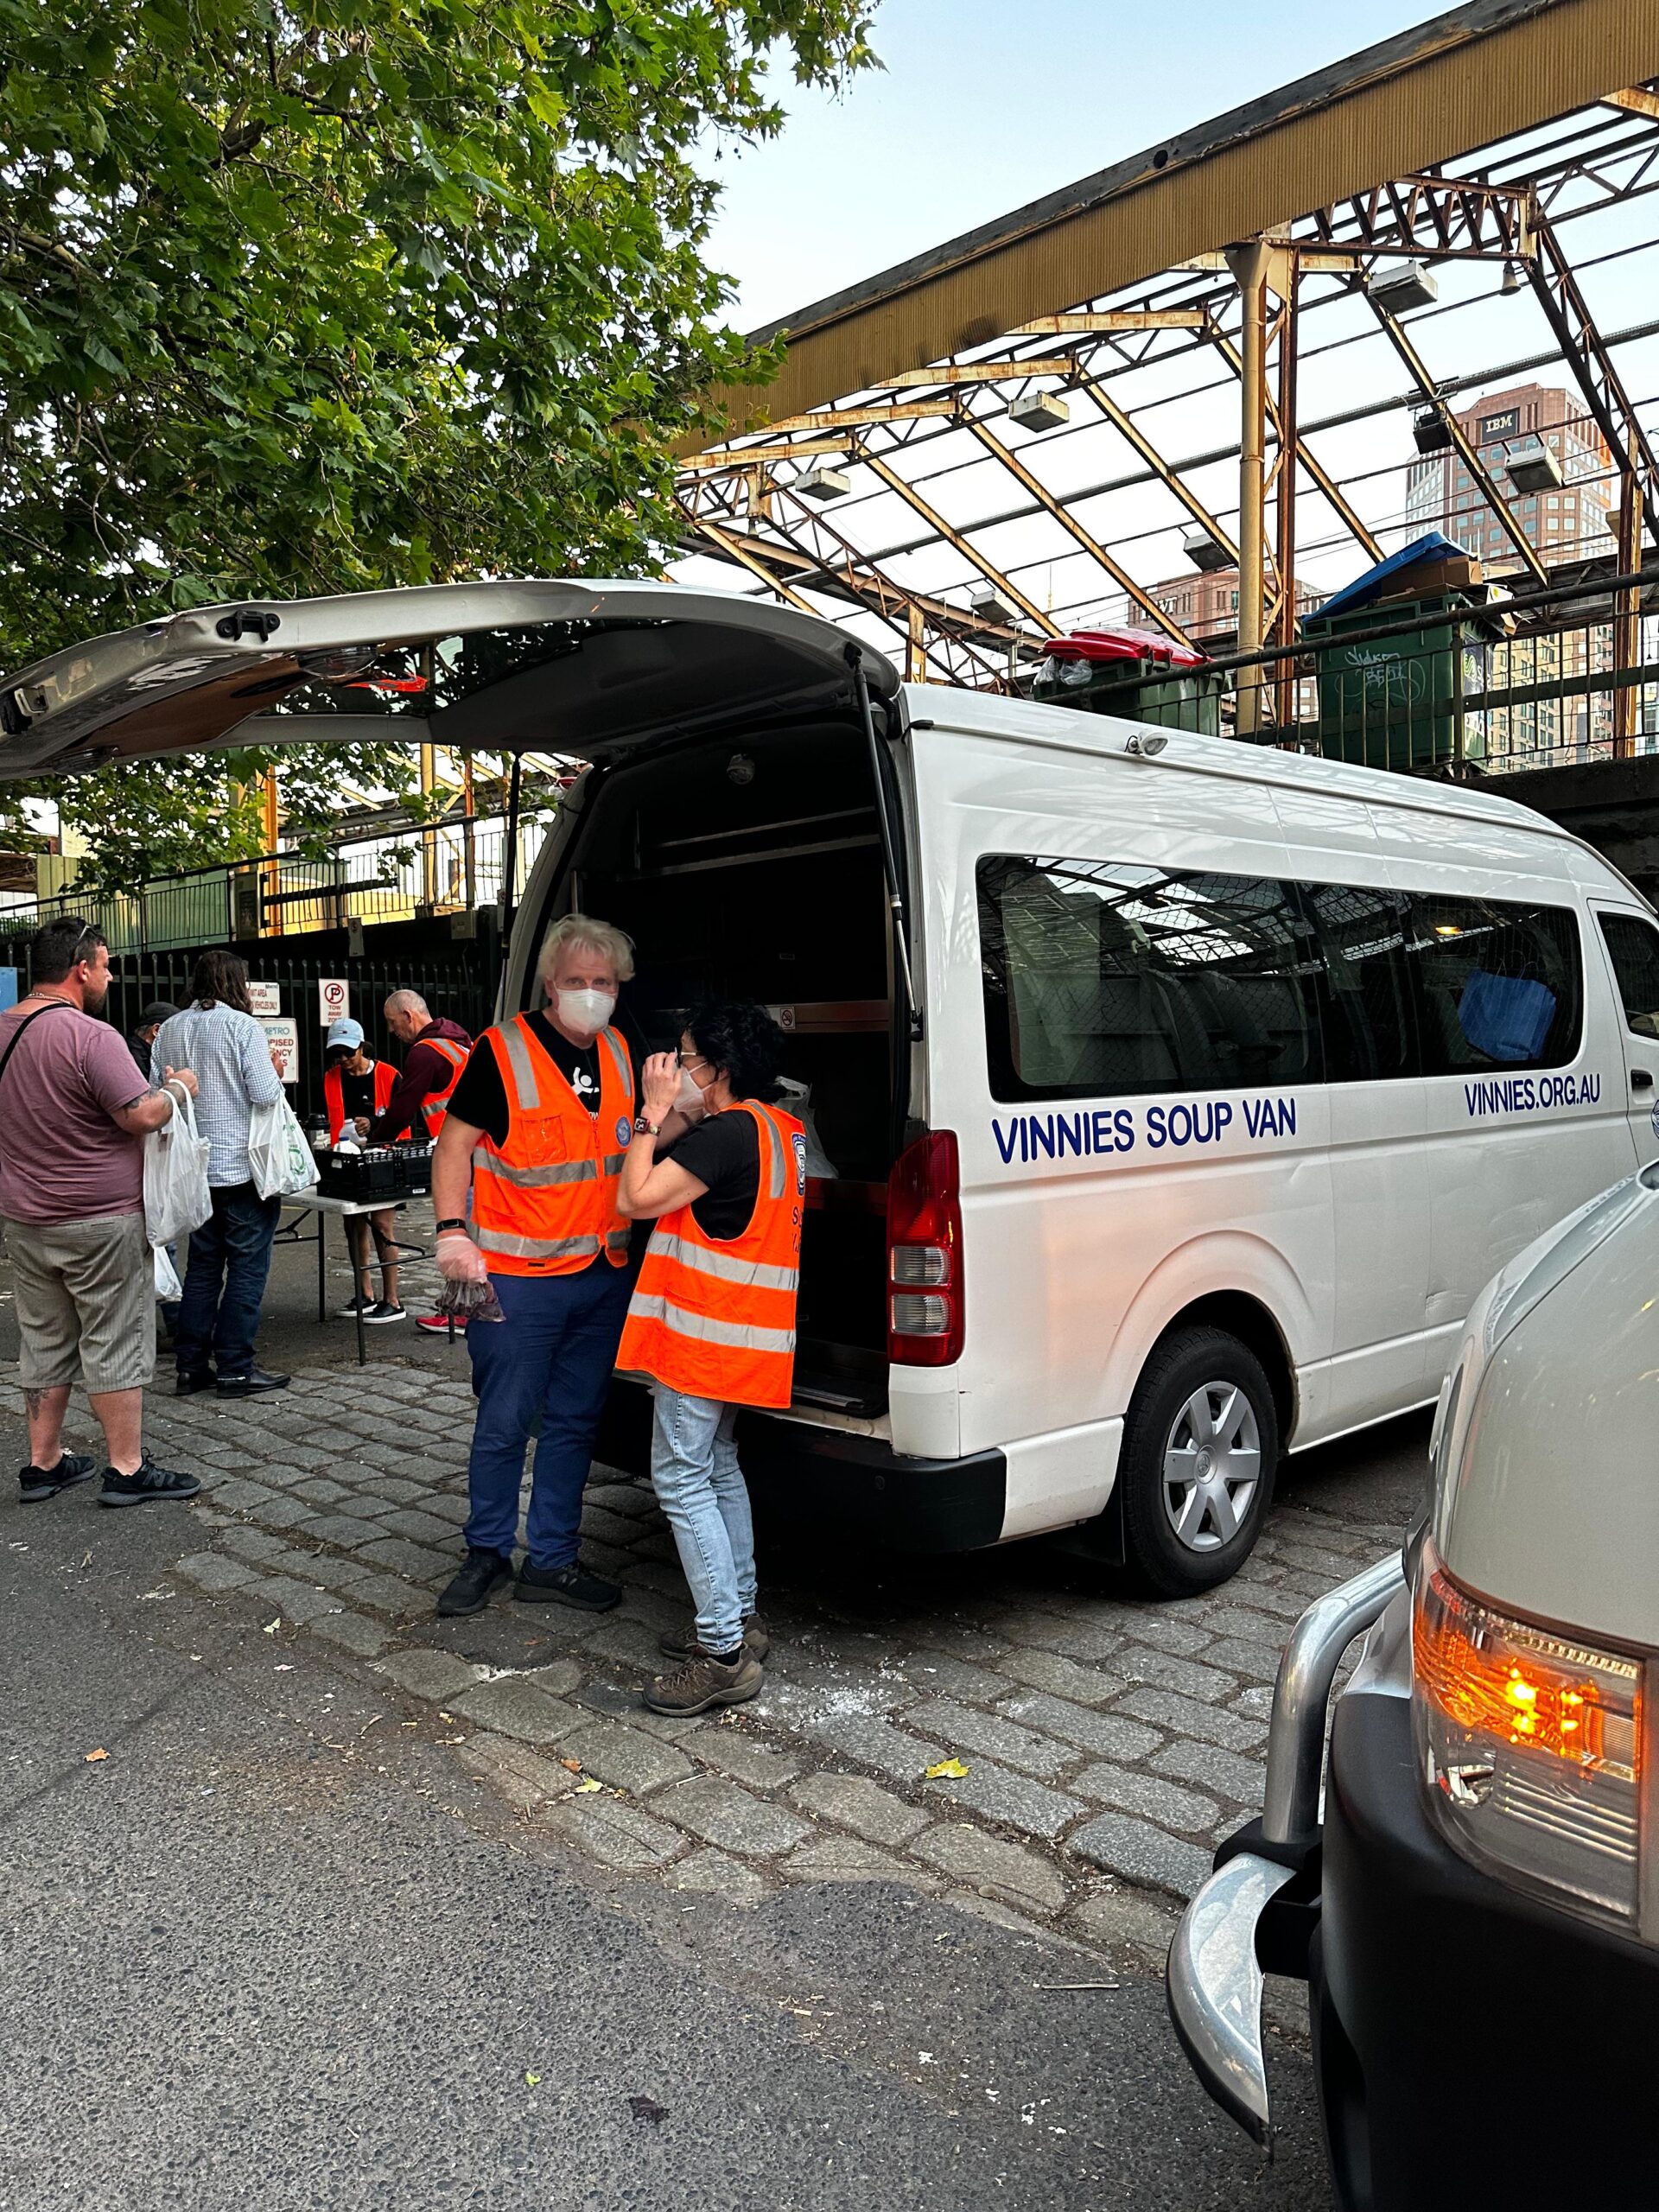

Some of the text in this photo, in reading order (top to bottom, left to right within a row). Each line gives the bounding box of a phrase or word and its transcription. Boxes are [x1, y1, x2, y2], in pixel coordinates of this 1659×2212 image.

[1486, 415, 1512, 432] IBM
[1464, 1073, 1600, 1116] VINNIES.ORG.AU
[991, 1097, 1297, 1165] VINNIES SOUP VAN
